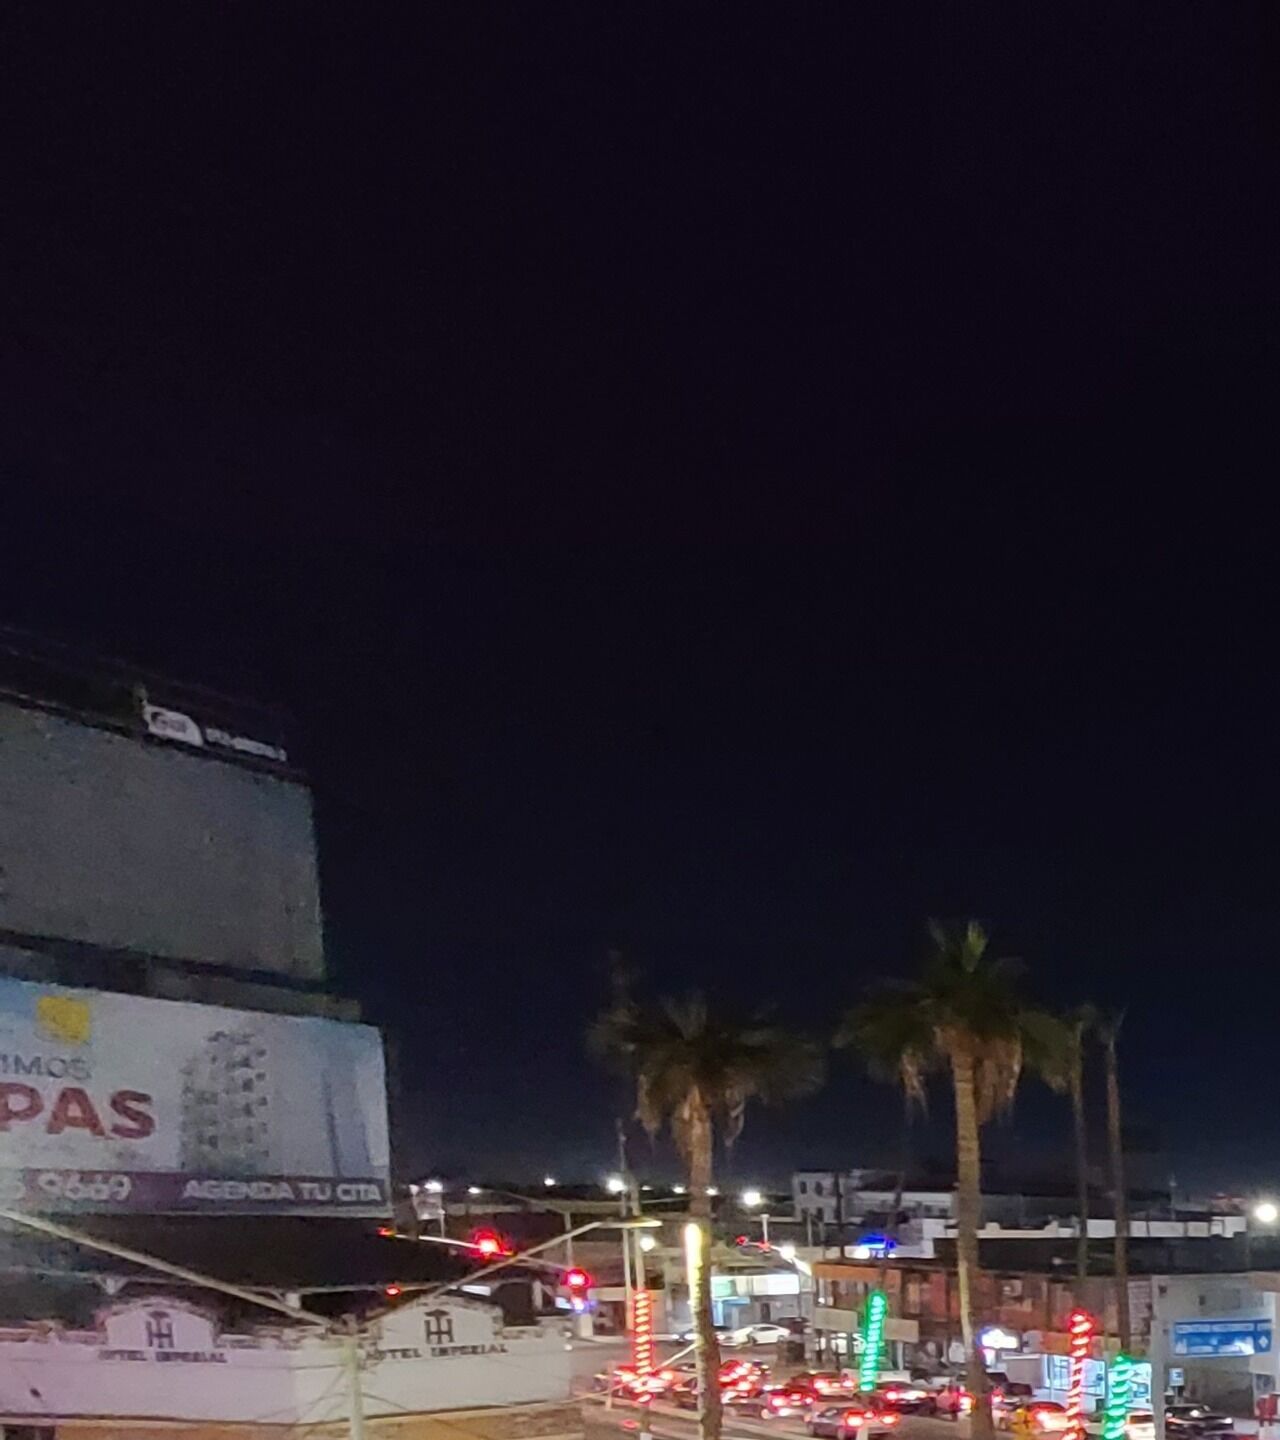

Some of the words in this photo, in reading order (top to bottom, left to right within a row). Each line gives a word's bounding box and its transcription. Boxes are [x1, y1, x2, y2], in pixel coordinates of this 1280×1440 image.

[0, 1053, 92, 1080] IMOS
[183, 1179, 294, 1200] AGENDA
[300, 1181, 331, 1200] TU
[336, 1183, 382, 1201] CITA
